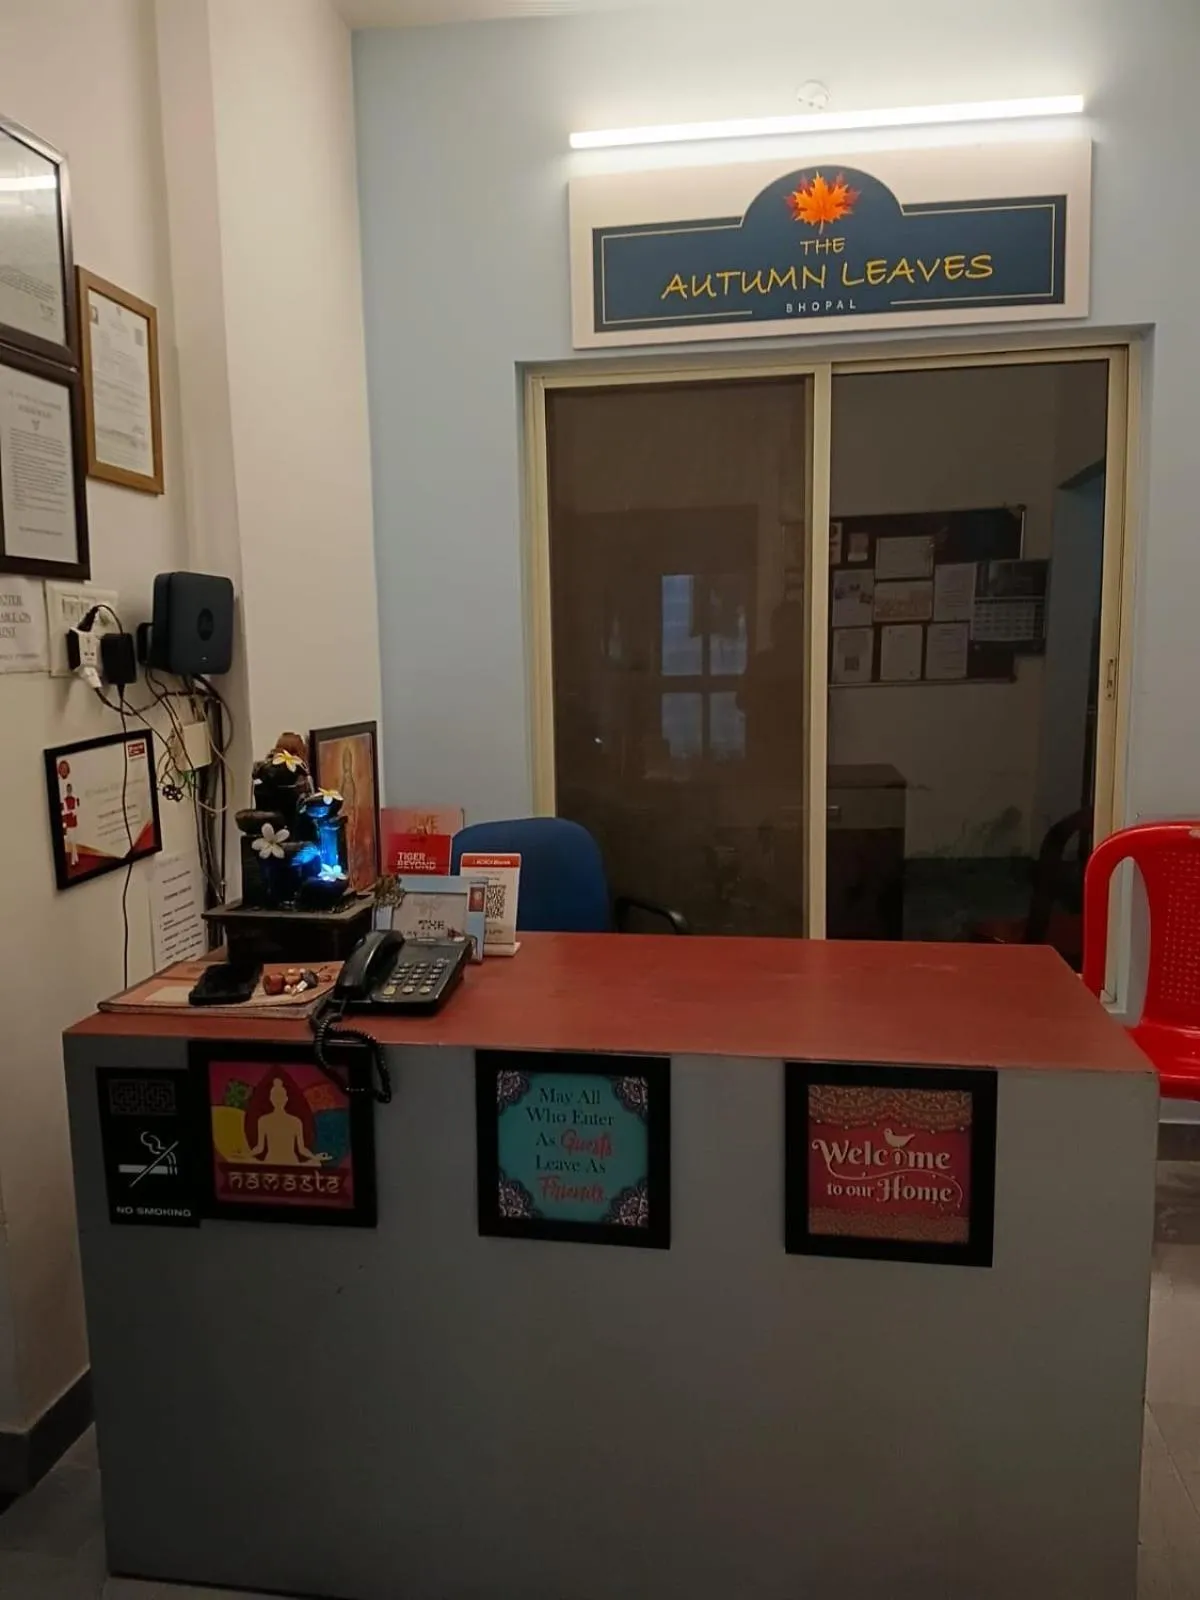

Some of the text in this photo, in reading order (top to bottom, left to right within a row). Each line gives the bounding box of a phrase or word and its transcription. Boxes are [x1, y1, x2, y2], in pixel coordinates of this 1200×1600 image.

[800, 237, 846, 256] THE
[661, 254, 994, 300] AUTUMN LEAVES
[786, 299, 858, 314] BHOPAL
[540, 1087, 601, 1105] May All
[526, 1107, 616, 1127] Who Enter
[535, 1132, 556, 1147] As
[535, 1154, 607, 1174] Leave As
[812, 1139, 951, 1170] Welcome
[228, 1171, 341, 1193] namaste
[827, 1177, 952, 1203] to our Home
[116, 1206, 192, 1218] NO SMOKING
